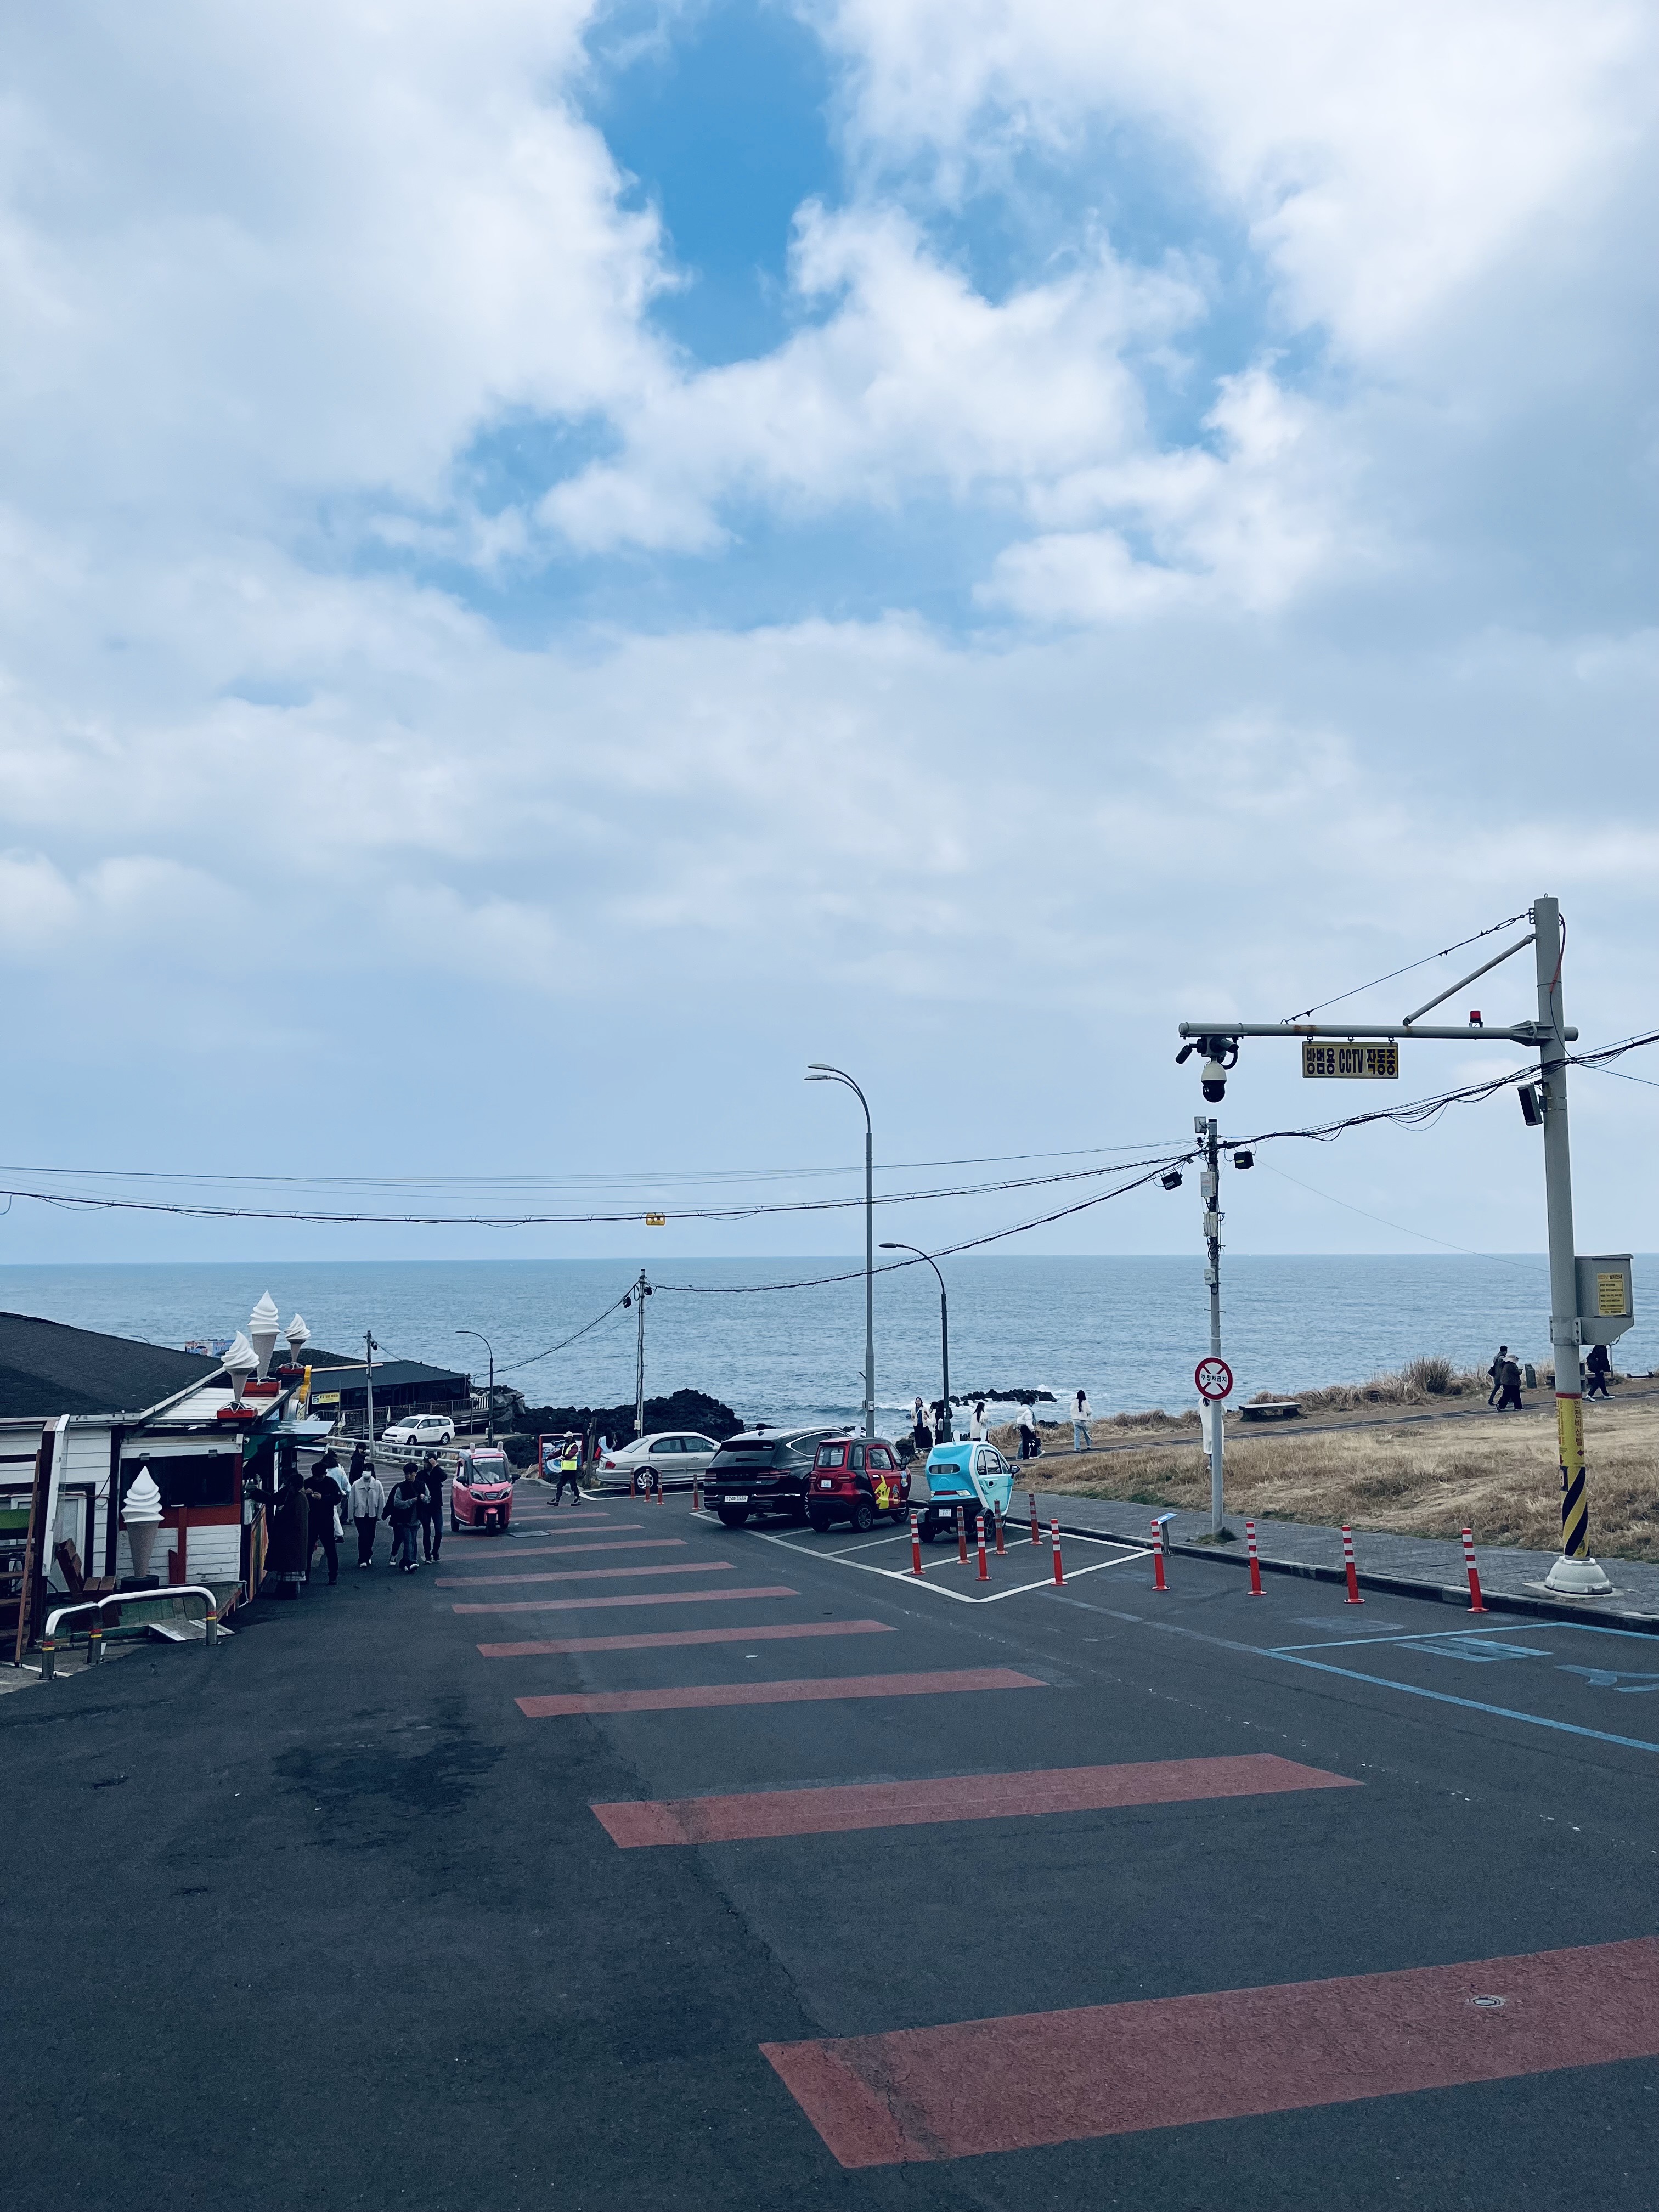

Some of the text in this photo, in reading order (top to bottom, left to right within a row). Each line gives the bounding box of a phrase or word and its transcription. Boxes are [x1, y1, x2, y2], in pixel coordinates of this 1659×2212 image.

[1306, 1048, 1395, 1076] 방범용 CCTV 작동중
[1201, 1374, 1227, 1383] 주정차금지
